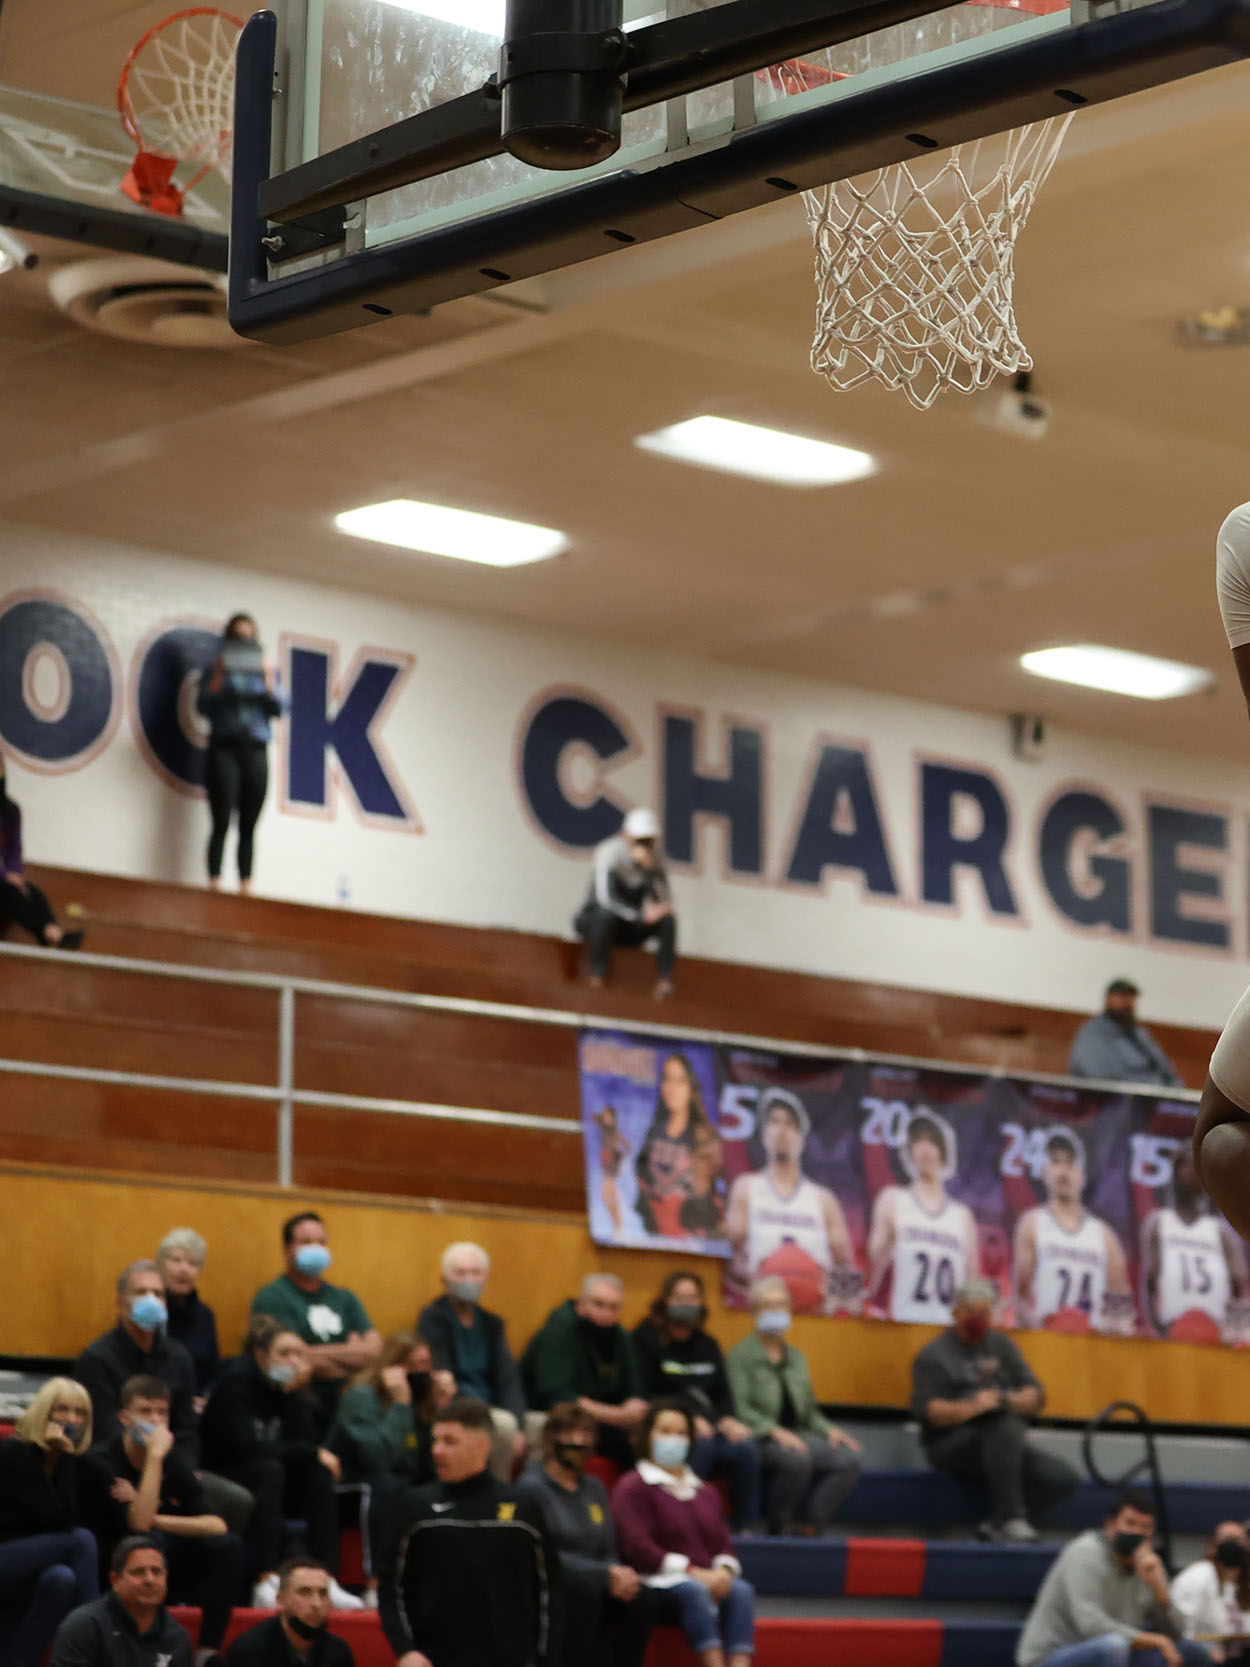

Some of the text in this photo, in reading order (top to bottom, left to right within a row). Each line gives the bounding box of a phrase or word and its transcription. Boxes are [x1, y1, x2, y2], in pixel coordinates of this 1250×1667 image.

[719, 1083, 760, 1141] 5
[860, 1096, 913, 1147] 20
[1000, 1122, 1048, 1179] 24
[1130, 1133, 1181, 1187] 15
[914, 1251, 956, 1305] 20
[1180, 1255, 1212, 1295] 15
